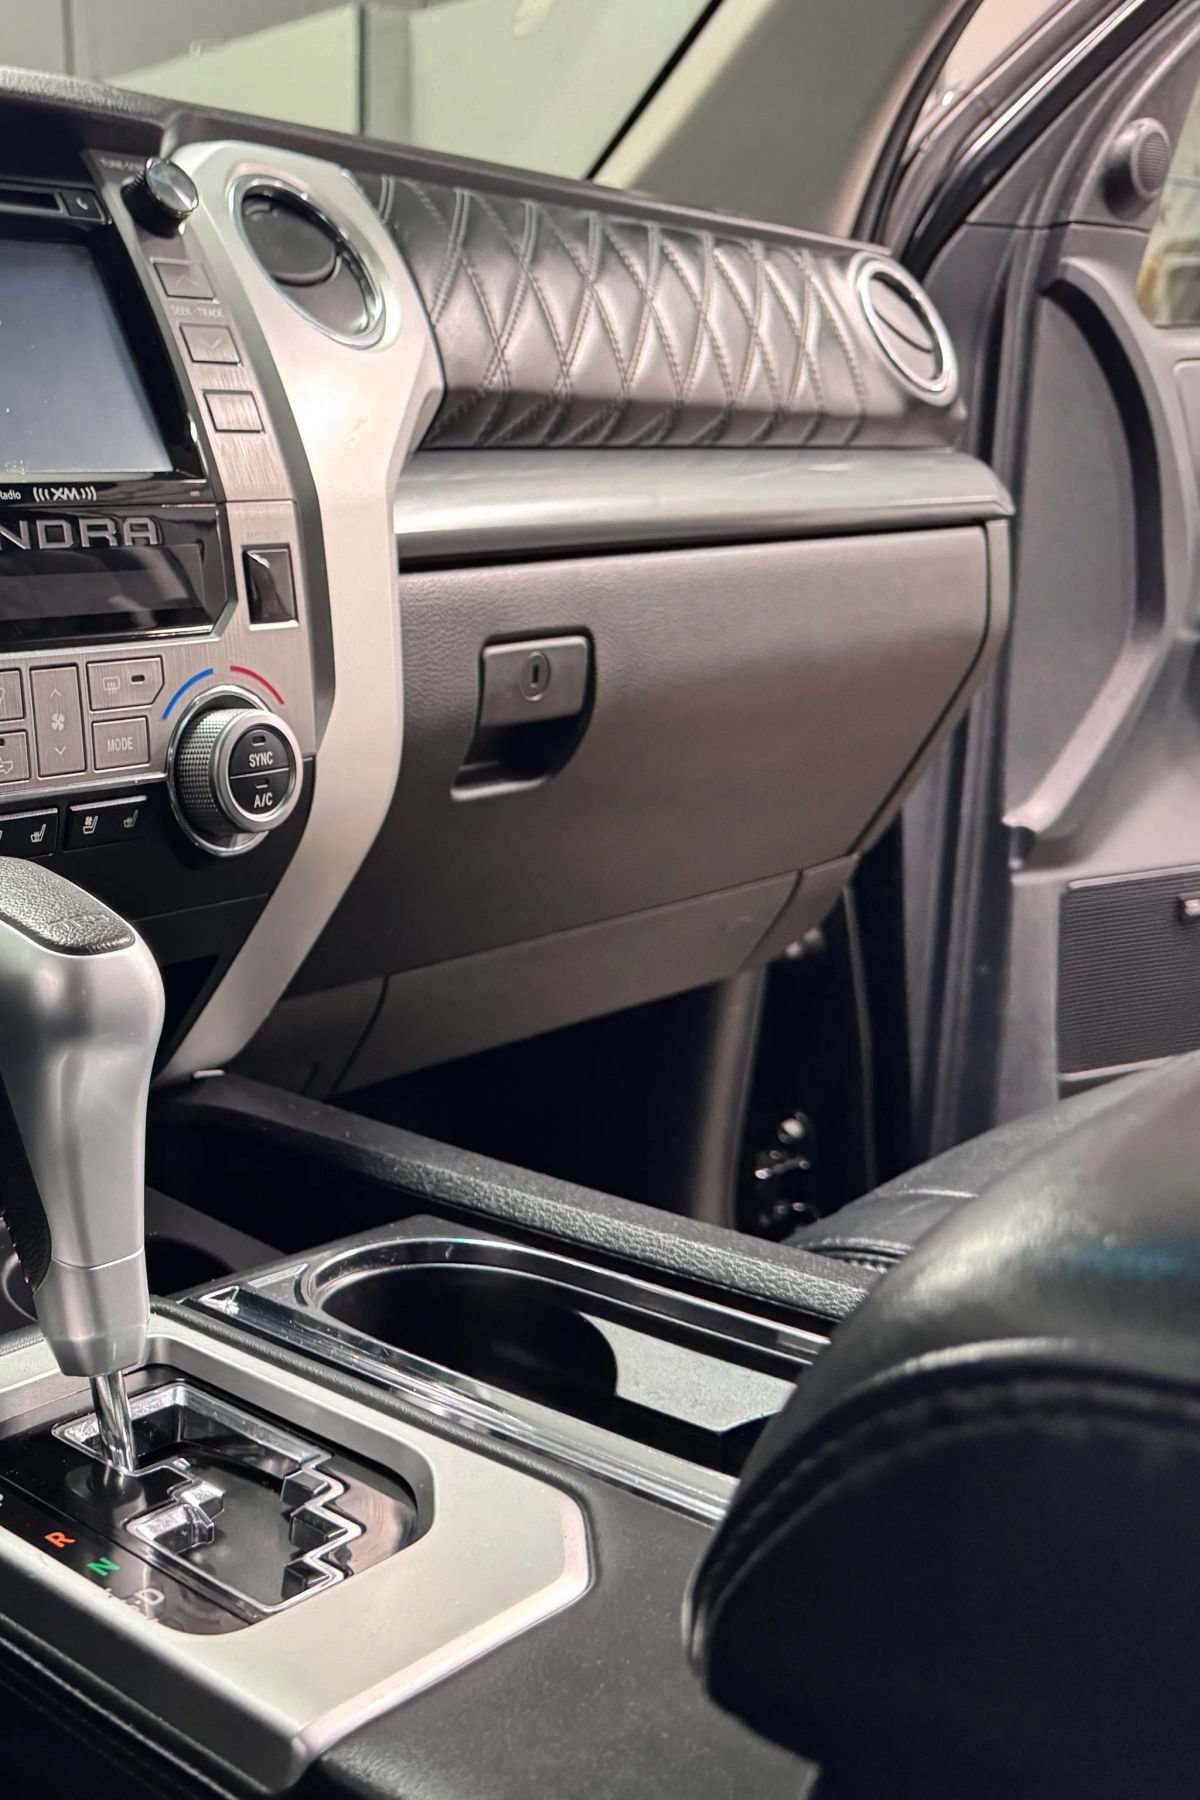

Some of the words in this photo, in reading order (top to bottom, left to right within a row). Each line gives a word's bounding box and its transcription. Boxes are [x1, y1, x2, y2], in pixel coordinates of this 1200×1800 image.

[107, 736, 134, 752] MODE
[249, 751, 274, 768] SYNC
[253, 792, 273, 808] A/C
[43, 1530, 76, 1548] R
[86, 1556, 120, 1577] N
